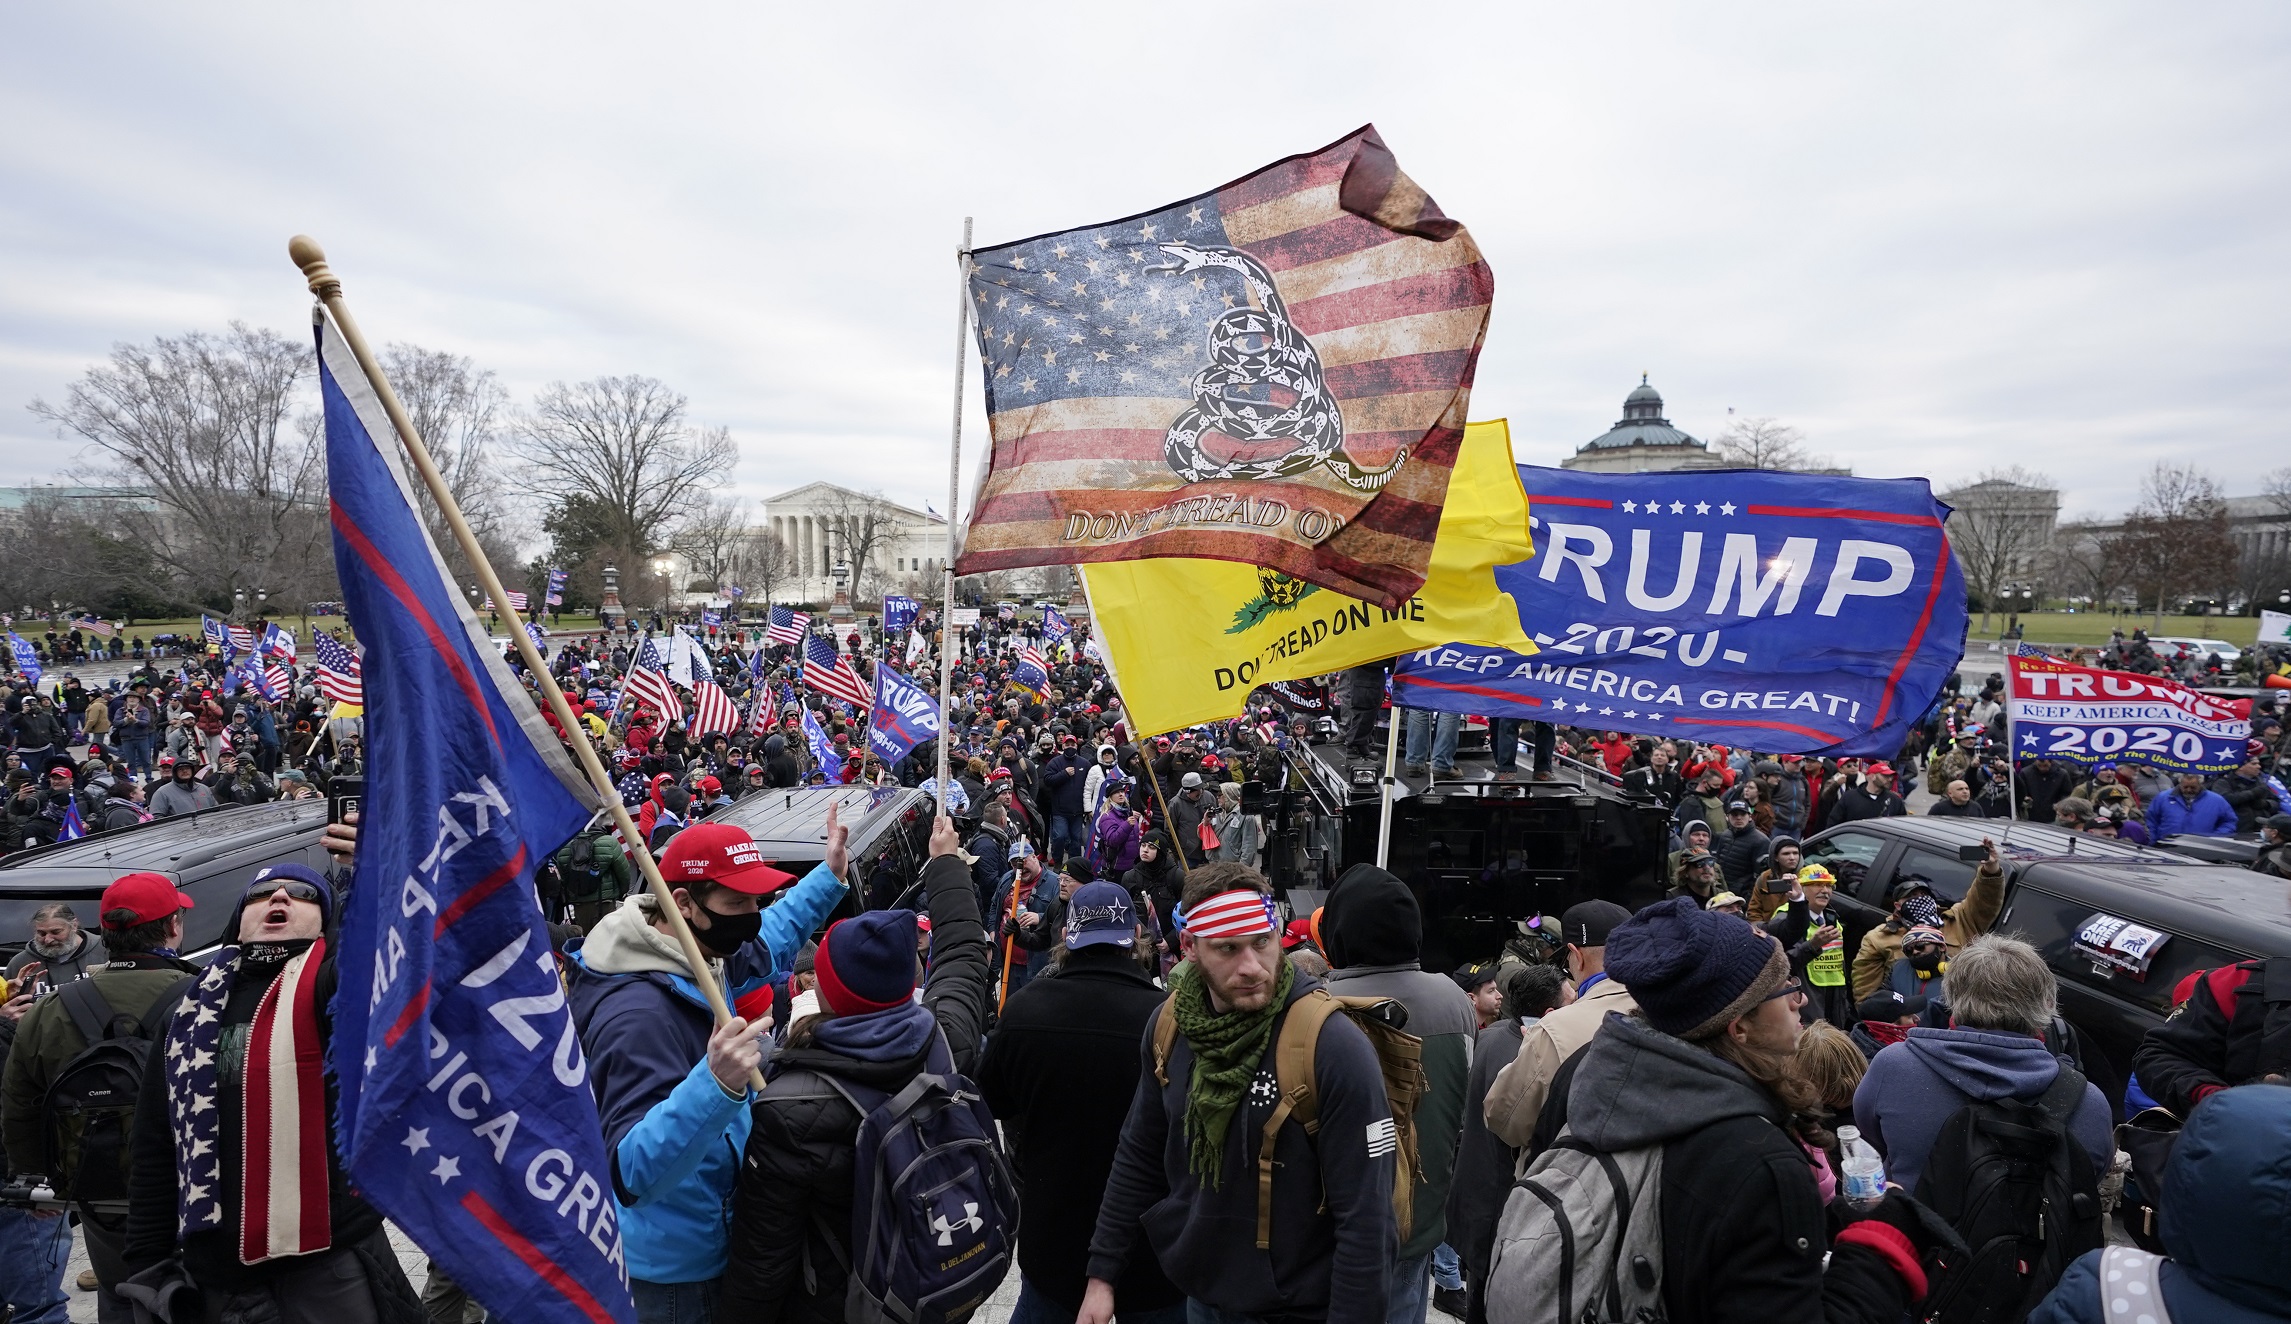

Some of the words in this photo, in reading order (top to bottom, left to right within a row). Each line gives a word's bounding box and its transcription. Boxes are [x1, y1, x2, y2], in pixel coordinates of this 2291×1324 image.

[1063, 507, 1164, 541] DON'T
[1166, 496, 1288, 527] TREAD
[1332, 601, 1370, 636] ON
[1382, 597, 1425, 623] ME
[1534, 622, 1748, 667] -2020-
[1414, 645, 1504, 675] KEEP
[1508, 662, 1686, 708] AMERICA
[1699, 687, 1862, 724] GREAT!
[881, 673, 940, 731] TRUMP
[2022, 704, 2071, 718] KEEP
[2074, 706, 2172, 719] AMERICA
[2176, 711, 2245, 735] GREAT!
[2048, 726, 2204, 762] 2020
[2020, 750, 2039, 758] For
[2150, 754, 2189, 769] United
[725, 843, 749, 856] MAKE
[733, 852, 758, 865] GREAT
[687, 867, 704, 875] 2020
[2085, 923, 2116, 938] ARE
[2096, 915, 2127, 930] WE
[2080, 931, 2109, 948] ONE
